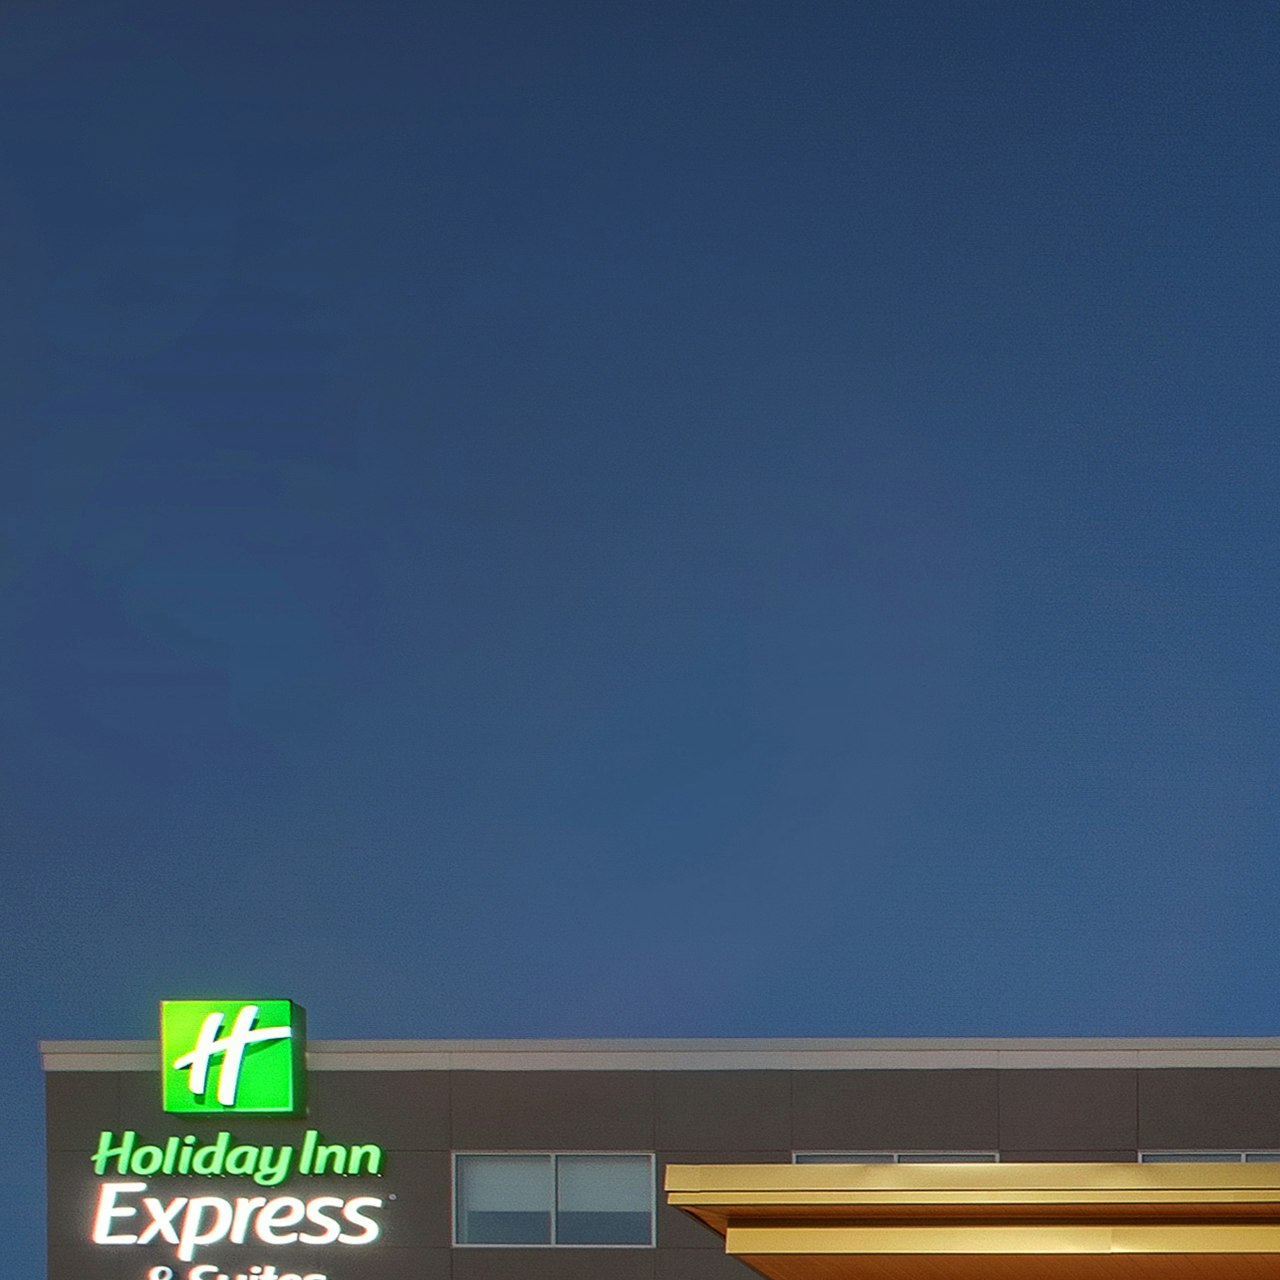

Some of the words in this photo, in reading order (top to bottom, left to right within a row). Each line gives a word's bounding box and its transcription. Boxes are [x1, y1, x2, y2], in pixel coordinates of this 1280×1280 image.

[91, 1131, 293, 1186] Holiday
[299, 1130, 381, 1175] Inn
[92, 1182, 383, 1262] Express
